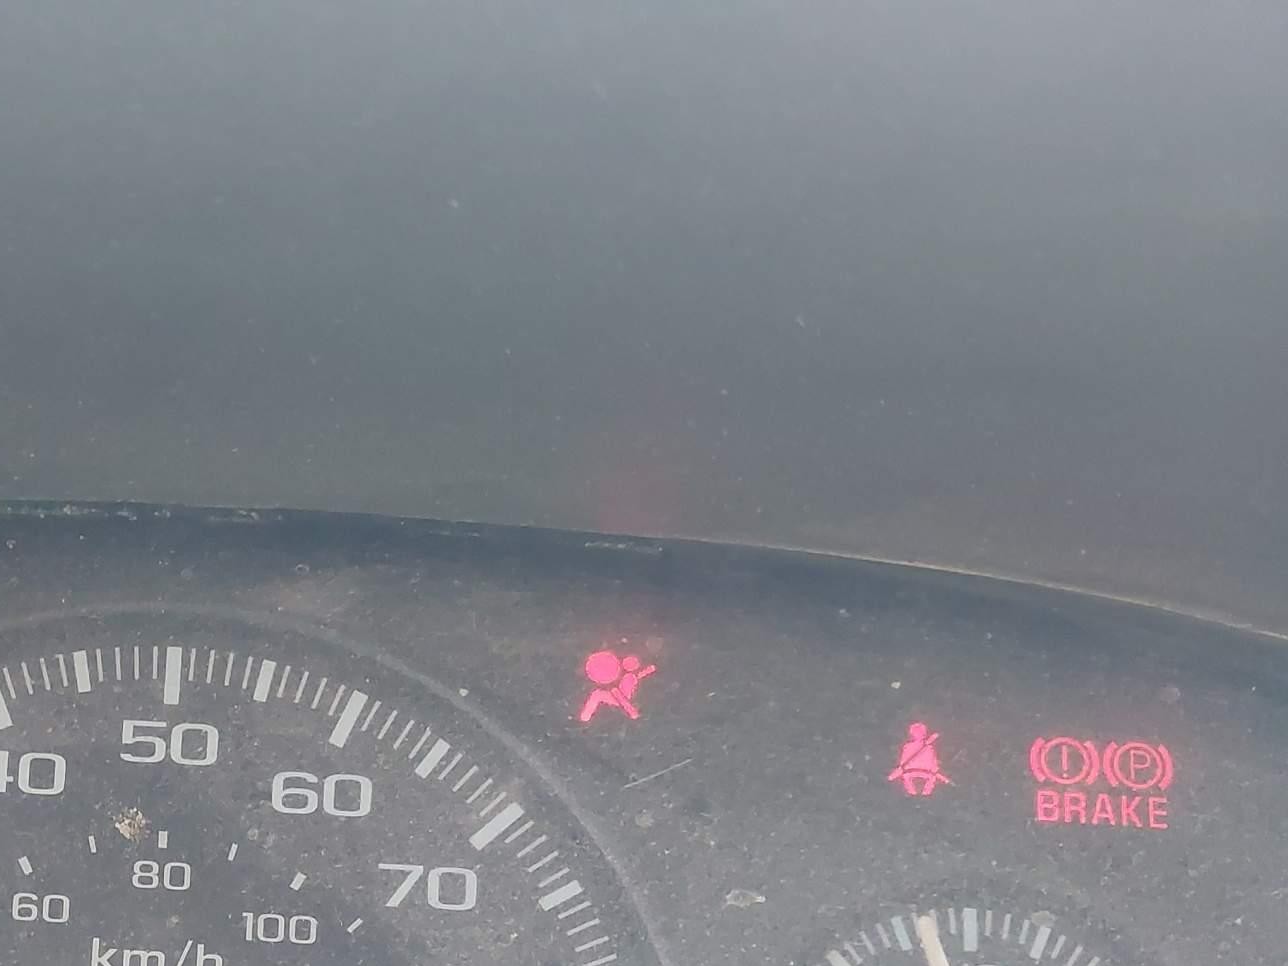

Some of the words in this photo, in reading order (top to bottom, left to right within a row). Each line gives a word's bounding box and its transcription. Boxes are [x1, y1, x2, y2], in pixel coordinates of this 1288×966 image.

[120, 719, 220, 766] 50
[271, 772, 373, 818] 60
[1036, 791, 1169, 828] BRAKE
[131, 860, 192, 891] 80
[377, 863, 478, 911] 70
[11, 892, 71, 923] 60
[241, 912, 318, 945] 100
